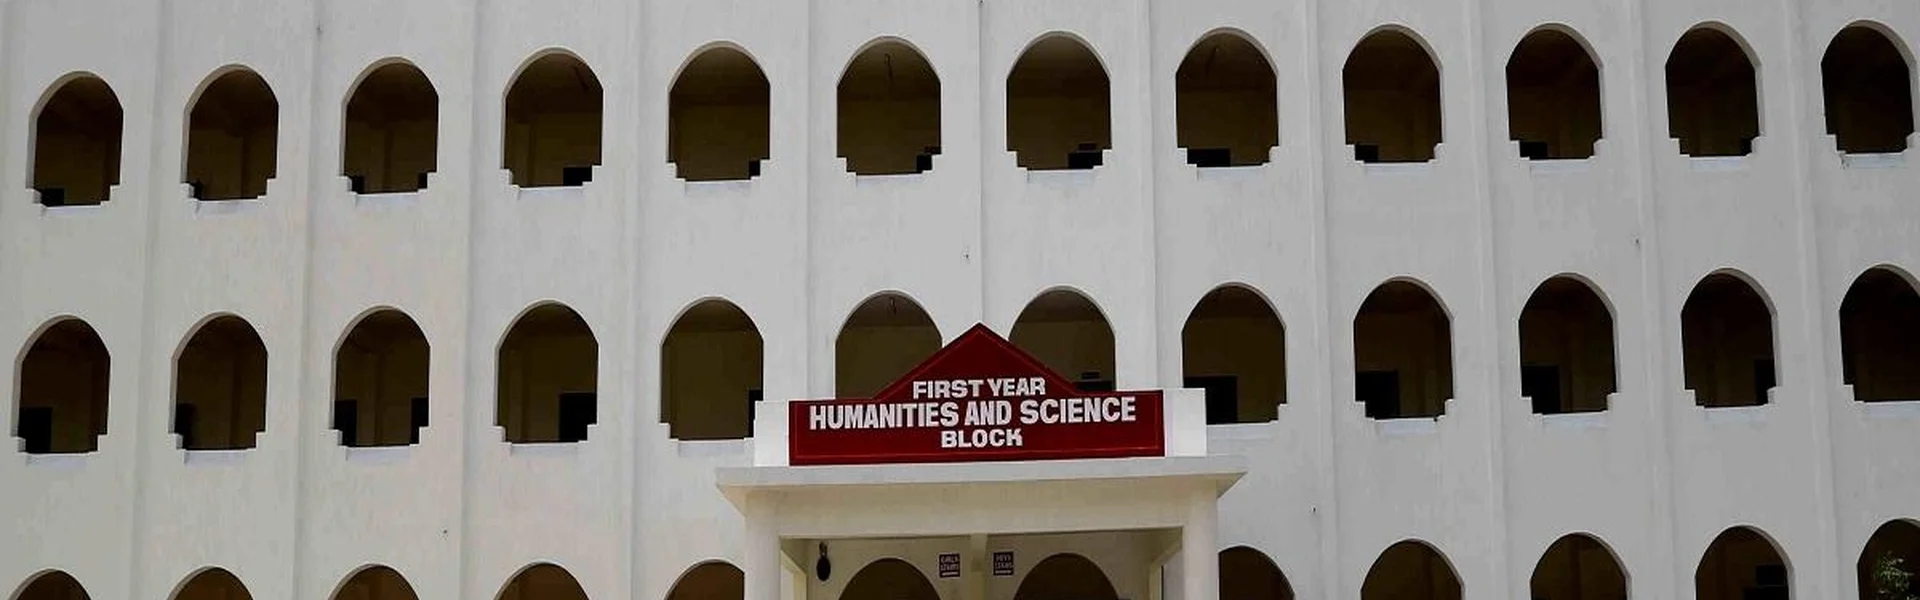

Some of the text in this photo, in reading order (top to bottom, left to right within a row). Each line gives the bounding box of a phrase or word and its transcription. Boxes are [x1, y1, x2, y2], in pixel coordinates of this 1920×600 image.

[913, 377, 1046, 400] FIRST YEAR
[809, 395, 1136, 430] HUMANITIES AND SCIENCE
[941, 428, 1023, 448] BLOCK
